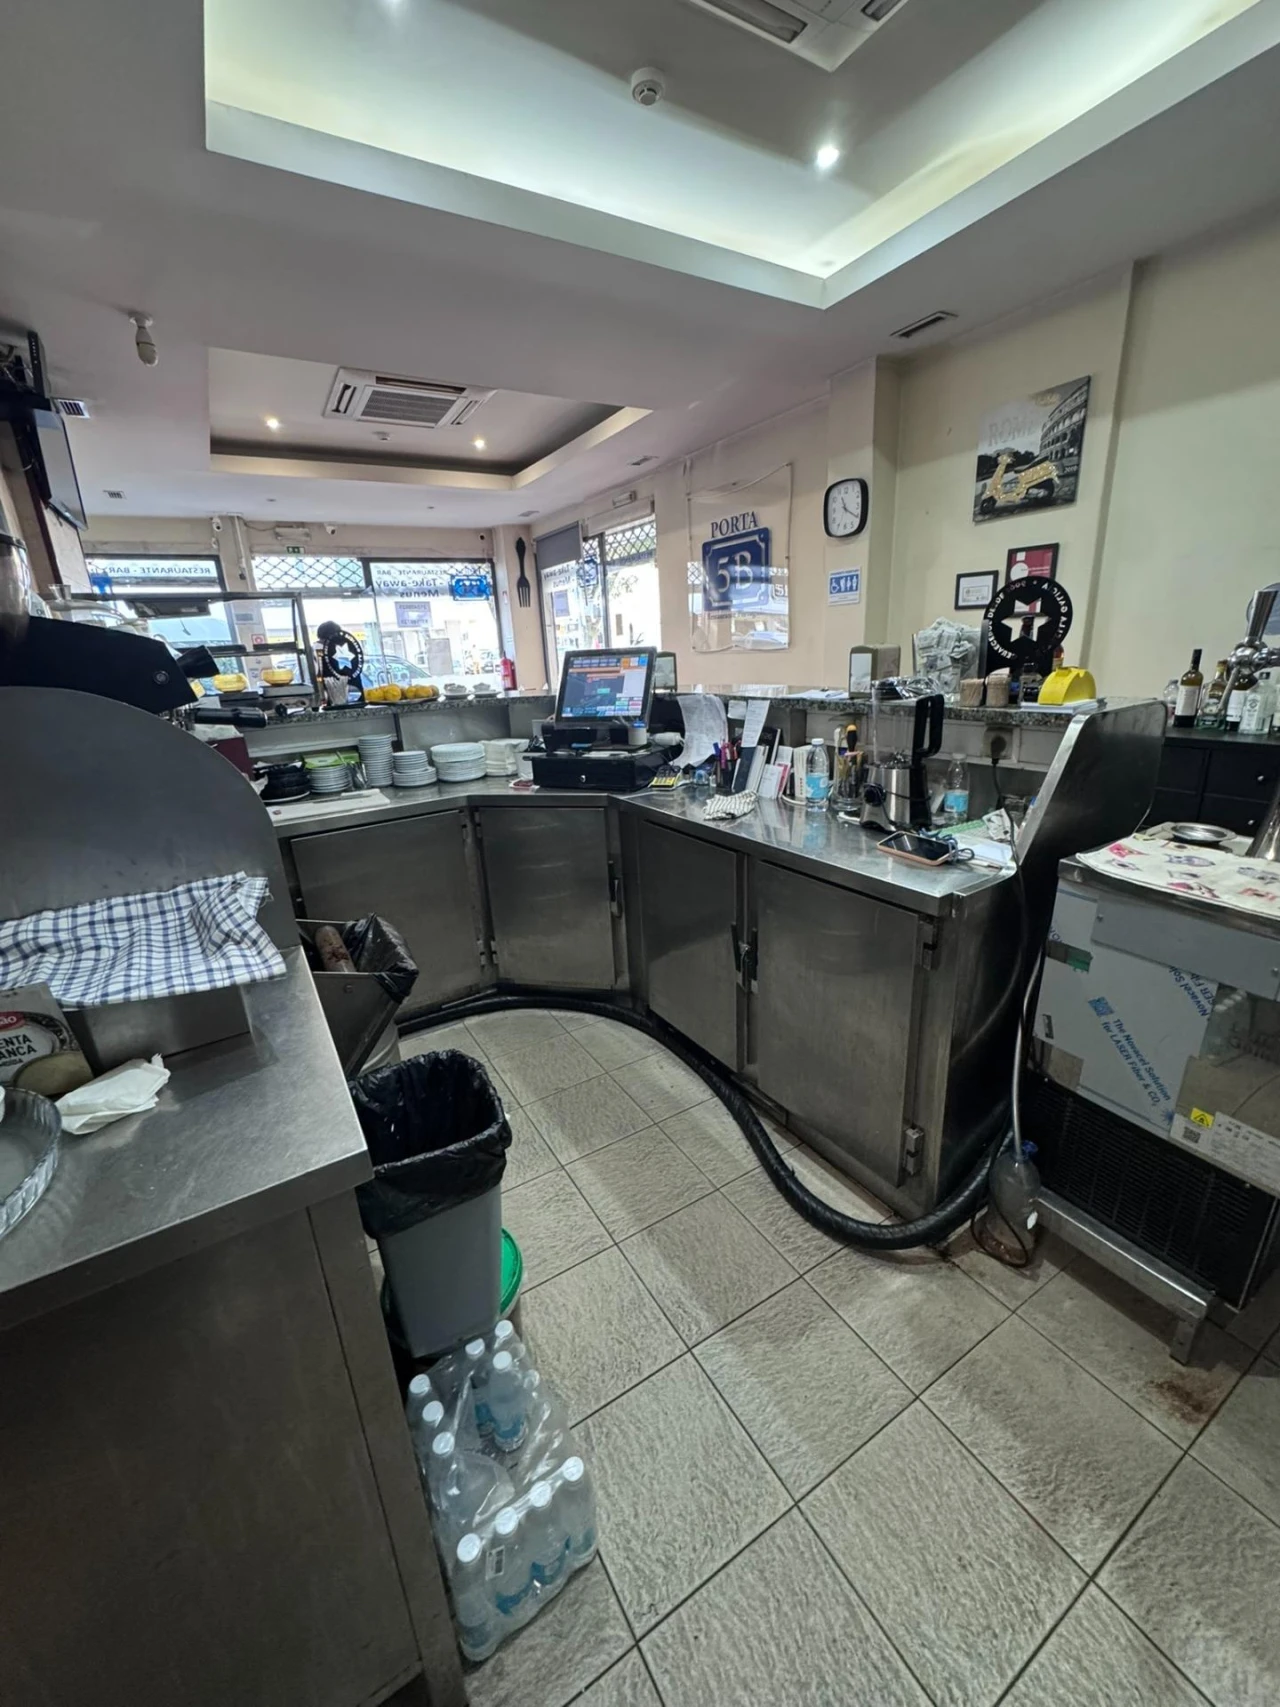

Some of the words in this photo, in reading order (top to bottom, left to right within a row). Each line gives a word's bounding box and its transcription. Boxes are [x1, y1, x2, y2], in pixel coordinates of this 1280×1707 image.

[711, 511, 759, 538] PORTA
[717, 551, 753, 593] 5B
[775, 583, 788, 596] 5
[1180, 983, 1208, 1018] Novacel
[1102, 1021, 1114, 1034] for
[1110, 1034, 1131, 1062] LASER
[1128, 1060, 1146, 1082] Fiber
[1114, 1018, 1126, 1034] The
[1124, 1034, 1150, 1066] Novacel
[1146, 1066, 1171, 1101] Solution
